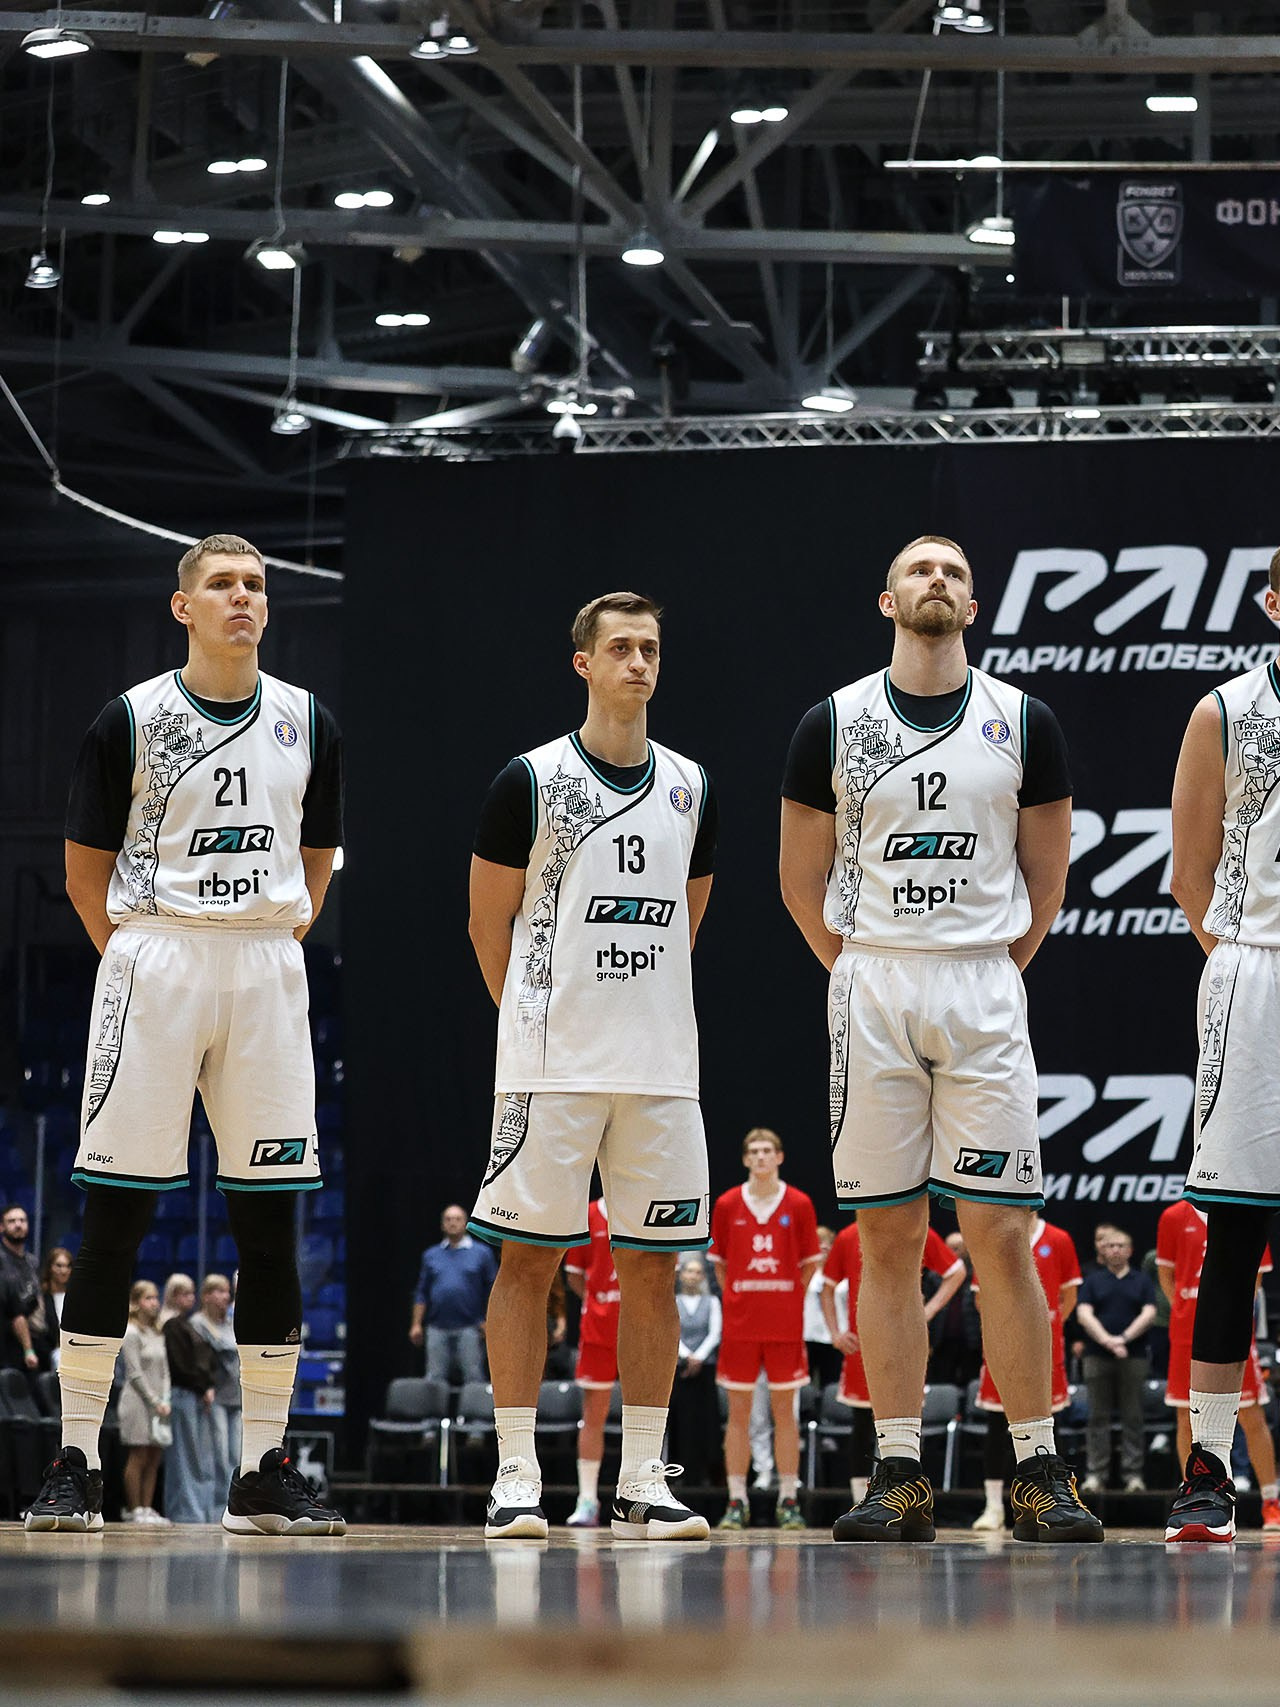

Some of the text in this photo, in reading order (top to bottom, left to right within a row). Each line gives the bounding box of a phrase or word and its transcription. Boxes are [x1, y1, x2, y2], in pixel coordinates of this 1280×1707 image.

[981, 647, 1082, 674] ПАРИ
[1085, 645, 1118, 673] И
[214, 768, 247, 806] 21
[912, 772, 946, 810] 12
[192, 830, 273, 853] PARI
[886, 835, 974, 858] PARI
[613, 835, 645, 874] 13
[588, 900, 671, 924] PARI
[893, 907, 925, 918] group
[596, 971, 629, 982] group
